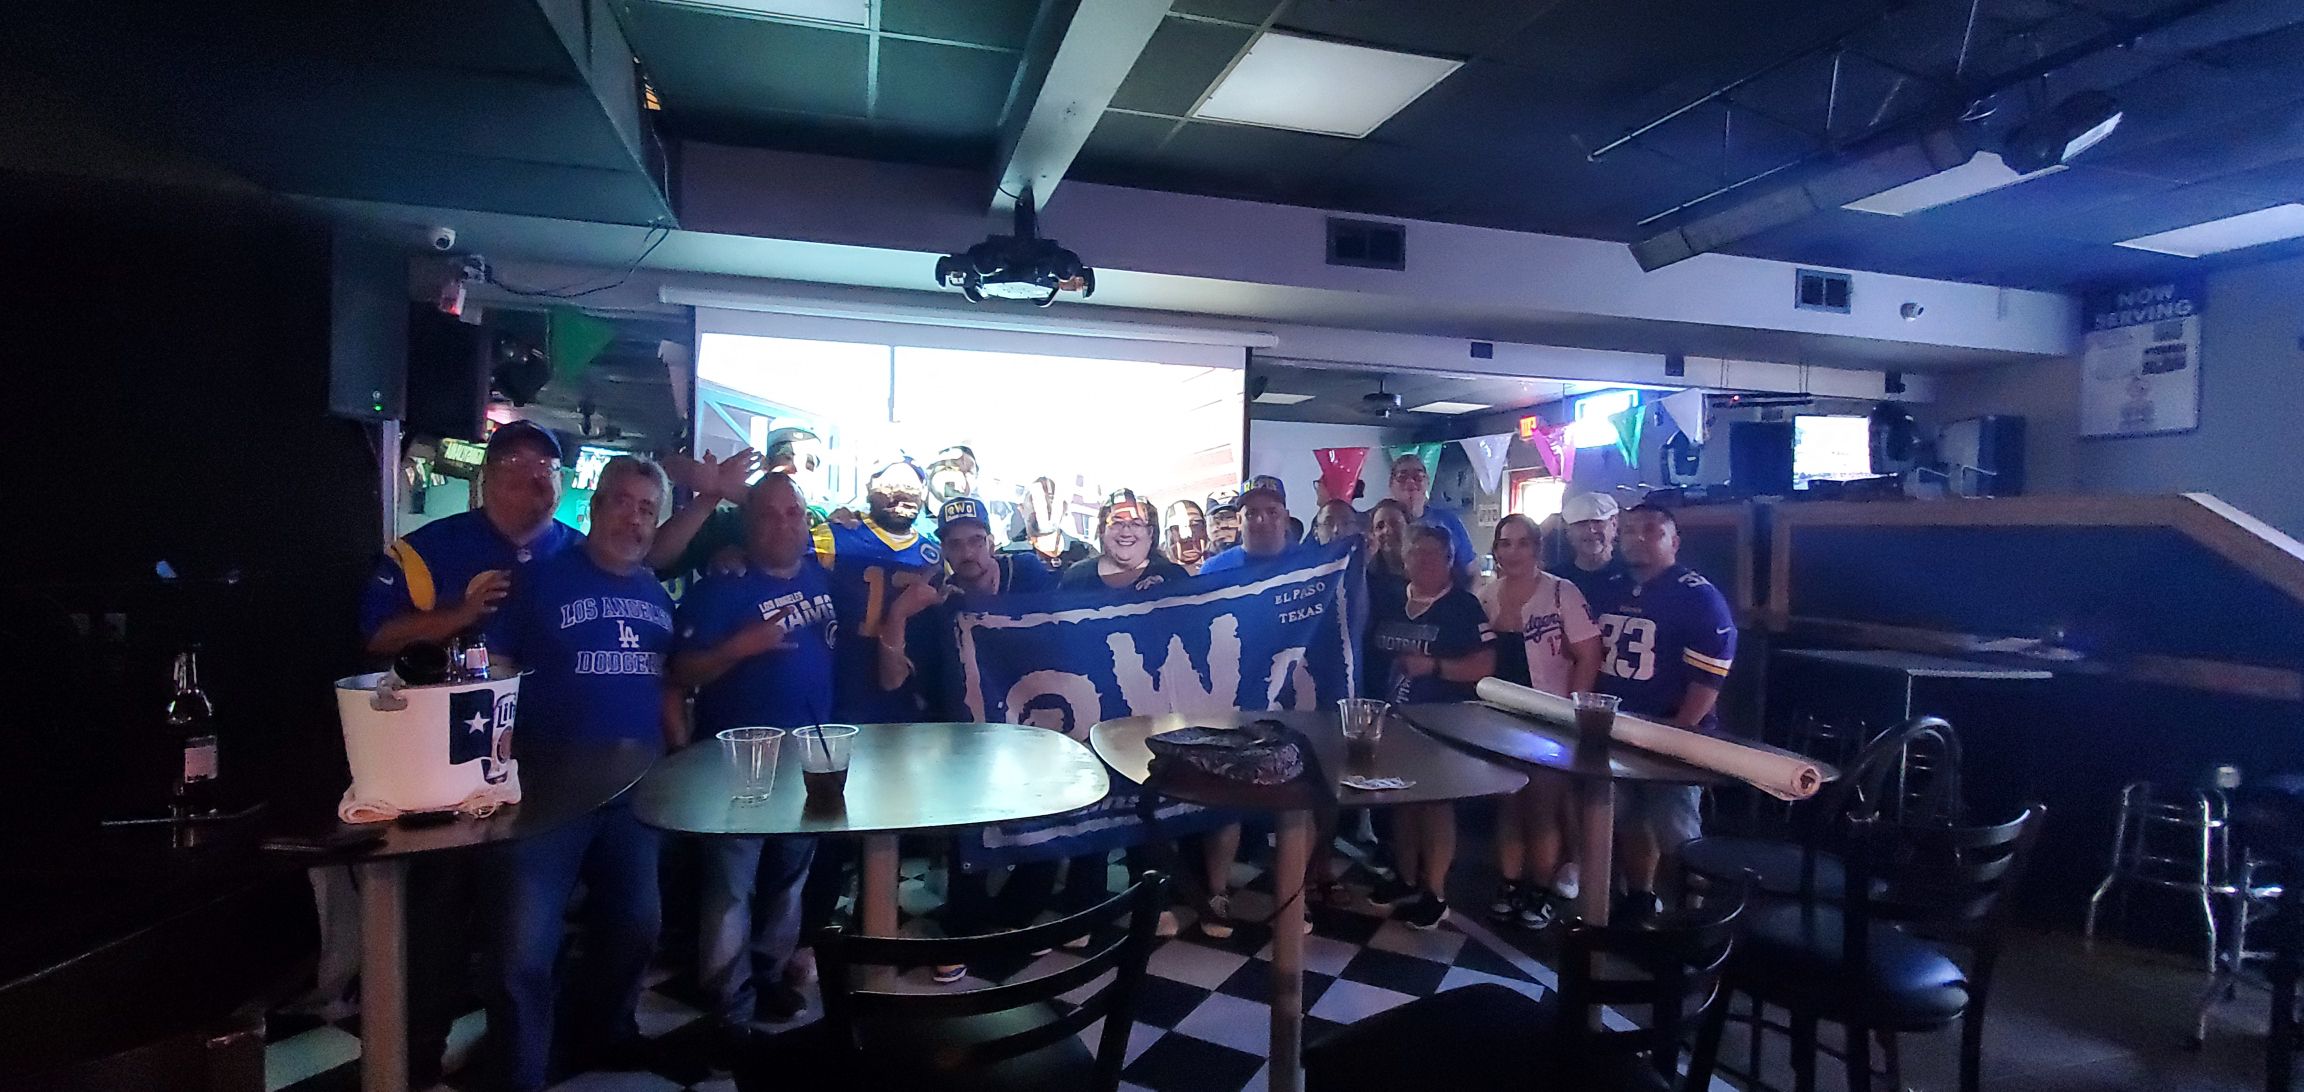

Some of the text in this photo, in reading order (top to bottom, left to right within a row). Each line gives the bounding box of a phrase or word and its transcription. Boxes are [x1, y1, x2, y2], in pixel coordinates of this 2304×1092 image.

[2118, 284, 2175, 306] NOW
[2095, 300, 2193, 330] SERVING
[1275, 581, 1326, 605] EL PASO
[560, 597, 599, 629] LOS
[1278, 603, 1324, 624] TEXAS
[616, 619, 640, 648] LA
